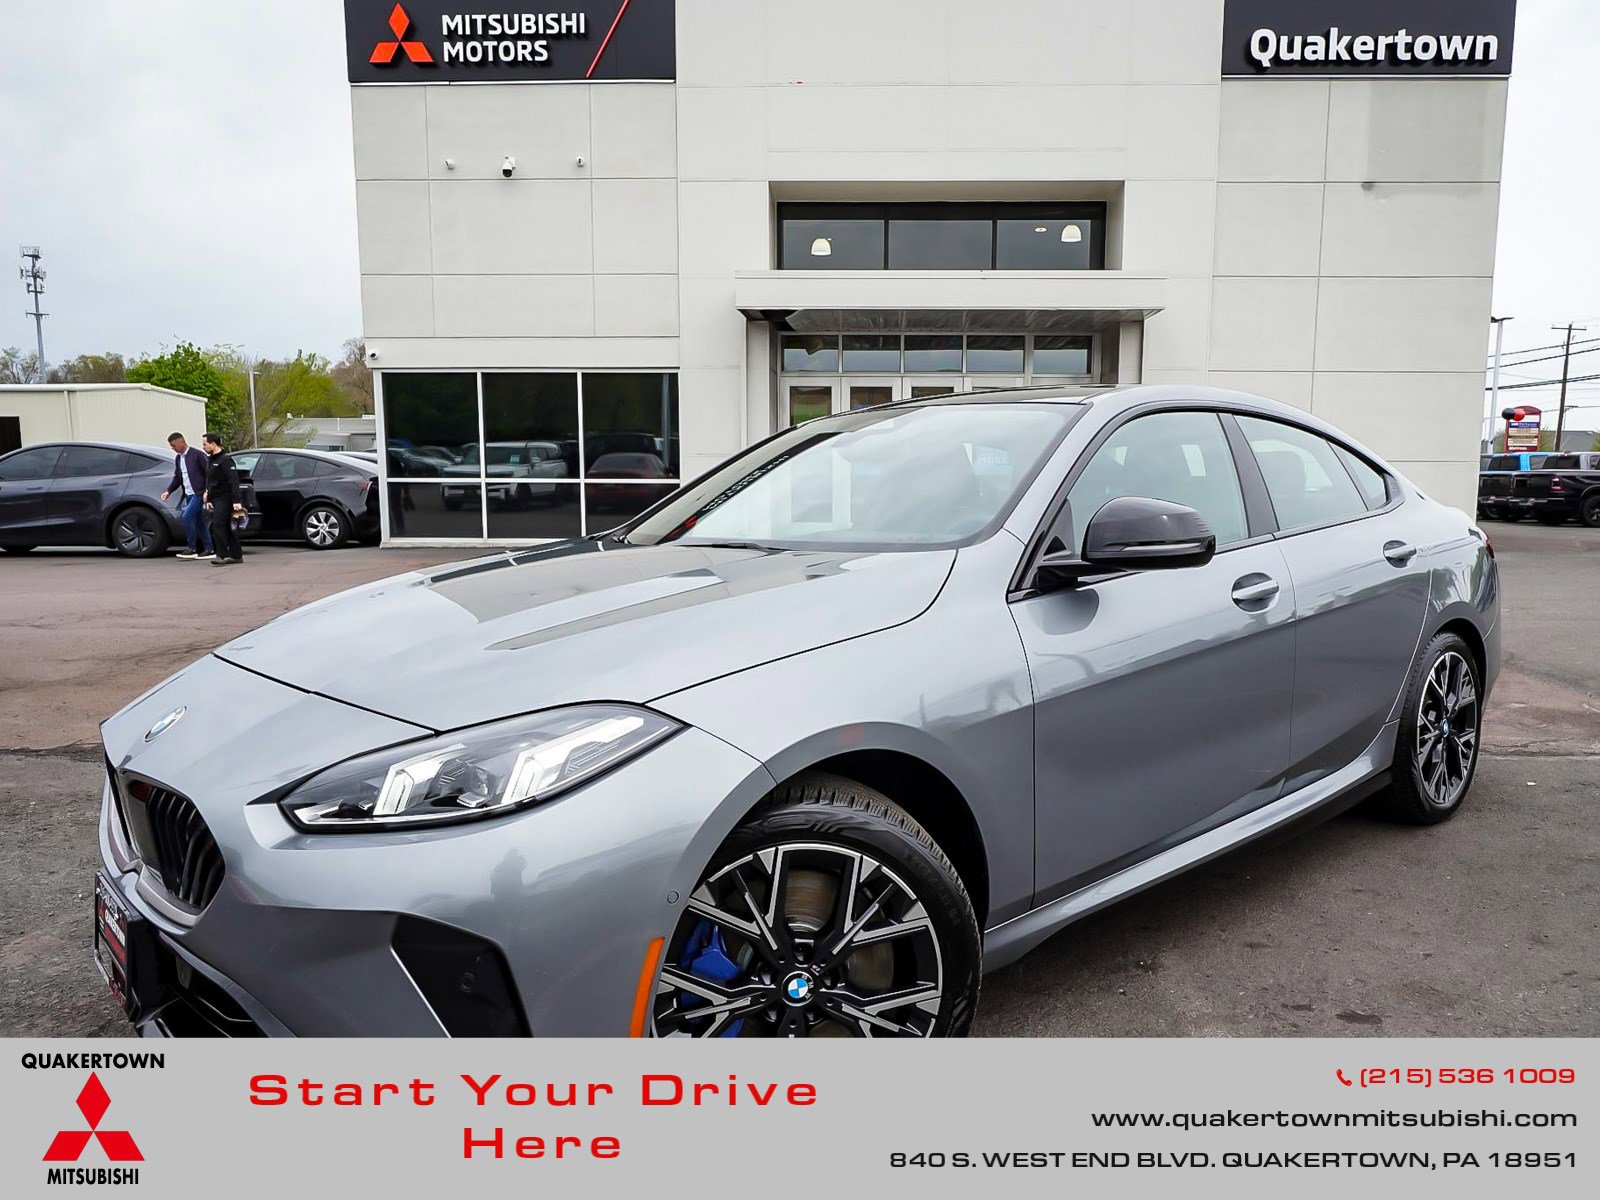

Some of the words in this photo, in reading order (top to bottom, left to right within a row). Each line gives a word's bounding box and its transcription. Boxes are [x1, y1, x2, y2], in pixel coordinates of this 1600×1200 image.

[441, 12, 586, 36] MITSUBISHI
[442, 40, 549, 63] MOTORS
[1250, 27, 1499, 68] Quakertown
